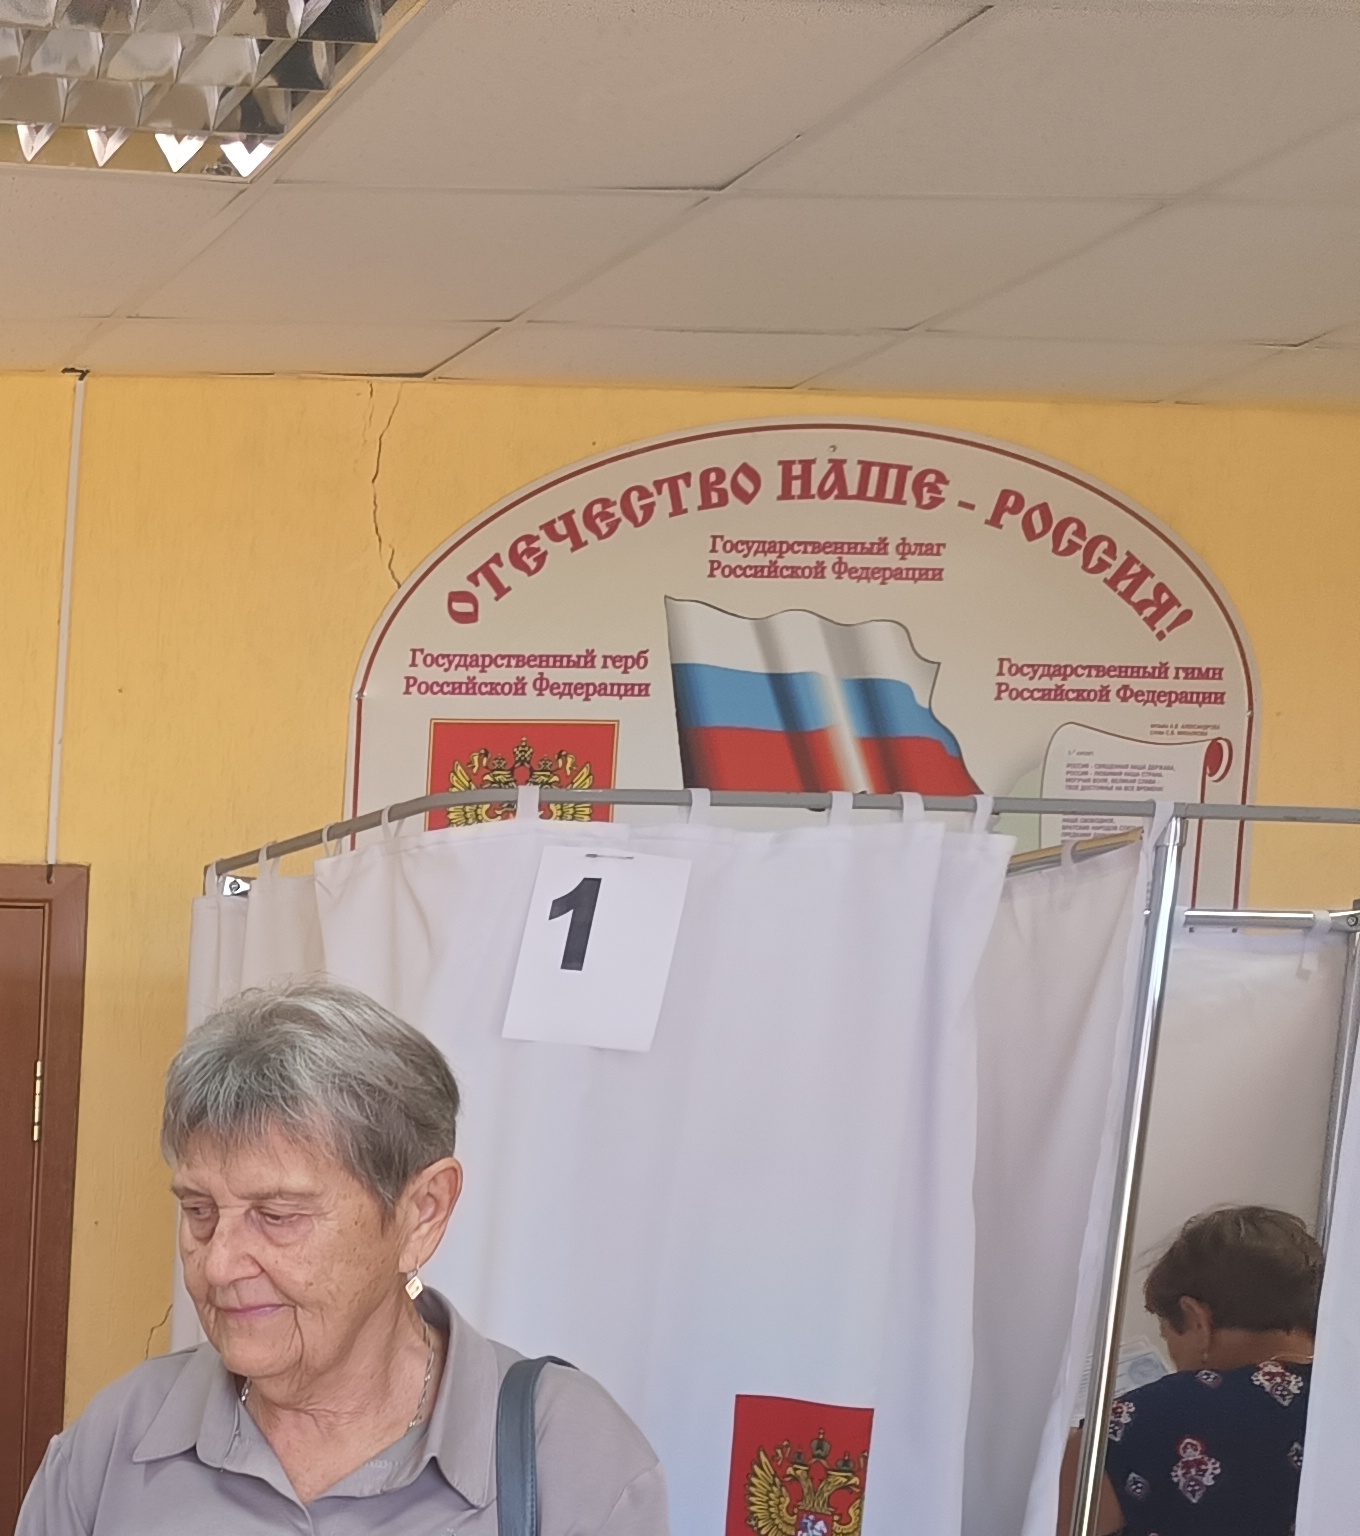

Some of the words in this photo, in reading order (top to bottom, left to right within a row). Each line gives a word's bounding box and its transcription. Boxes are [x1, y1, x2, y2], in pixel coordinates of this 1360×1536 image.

[447, 461, 761, 624] ОТЕЧЕСТВО
[776, 457, 950, 511] НАШЕ
[984, 488, 1194, 642] РОССИЯ!
[708, 534, 889, 559] Государственный
[894, 537, 946, 561] флаг
[706, 559, 827, 580] Российской
[831, 557, 945, 585] Федерации
[408, 647, 596, 672] Государственный
[600, 648, 650, 673] герб
[996, 656, 1170, 681] Государственный
[1172, 664, 1225, 682] гимн
[402, 674, 527, 698] Российской
[532, 672, 651, 702] Федерации
[993, 682, 1111, 704] Российской
[1115, 683, 1226, 708] Федерации
[547, 876, 603, 972] 1
